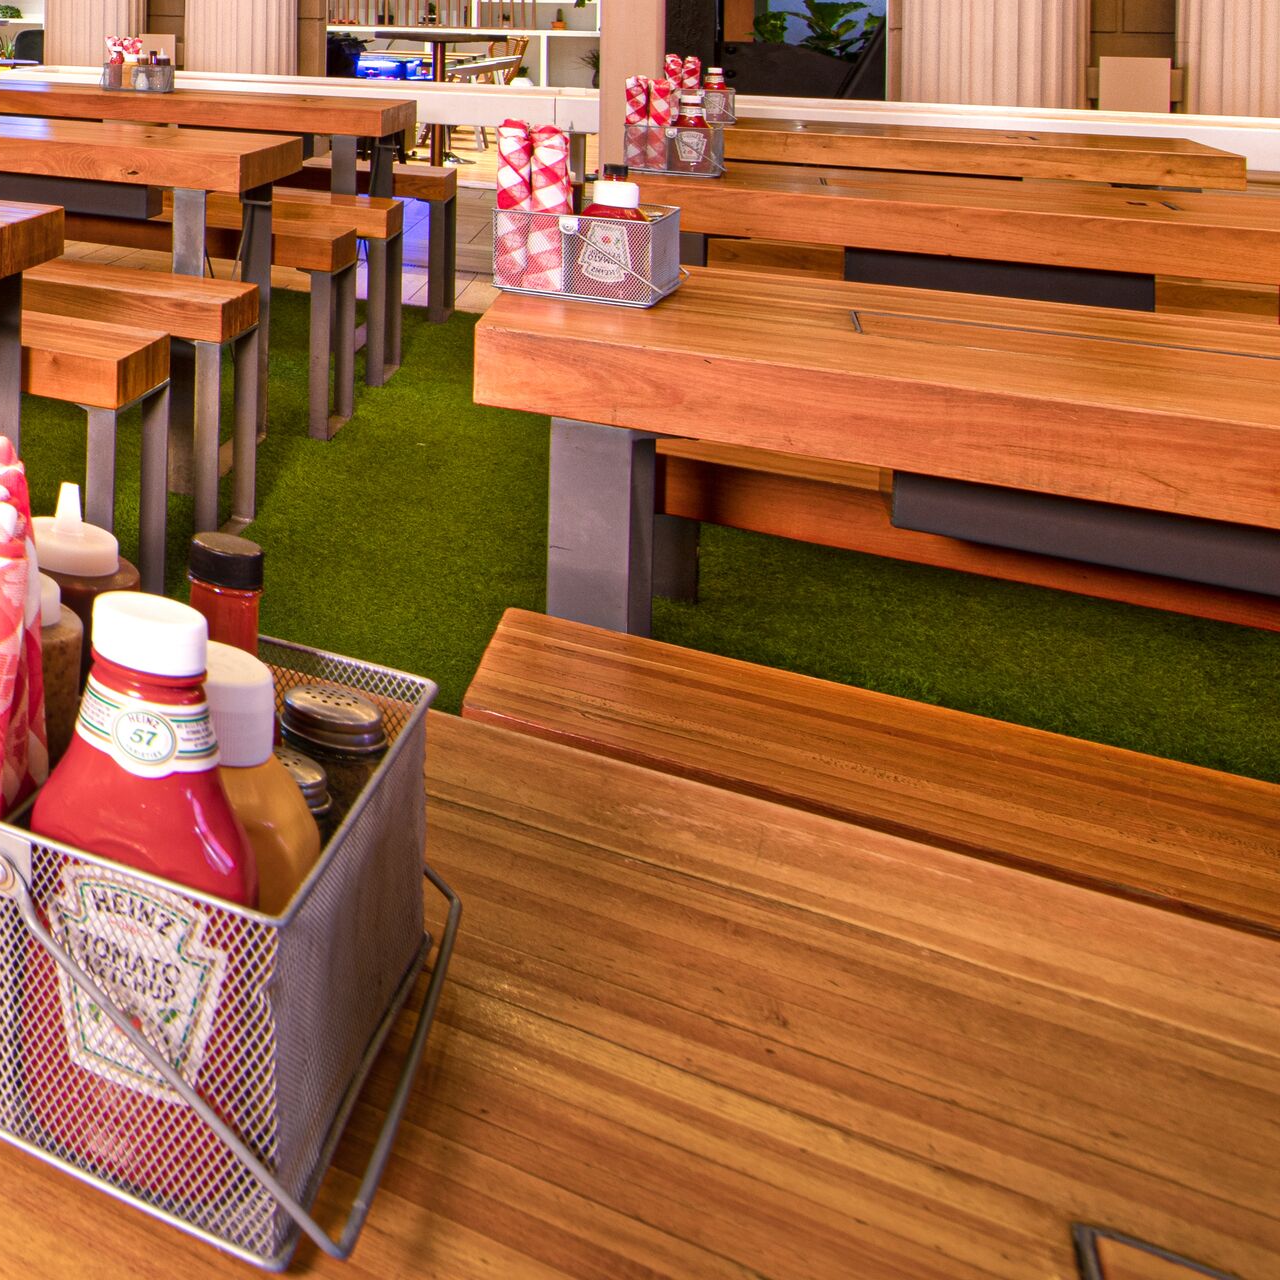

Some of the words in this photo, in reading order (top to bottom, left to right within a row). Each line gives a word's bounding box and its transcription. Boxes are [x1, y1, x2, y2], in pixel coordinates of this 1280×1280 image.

[127, 713, 160, 730] HEINZ
[130, 728, 158, 746] 57
[90, 890, 175, 936] HEINZ
[79, 929, 181, 984] TOMATO
